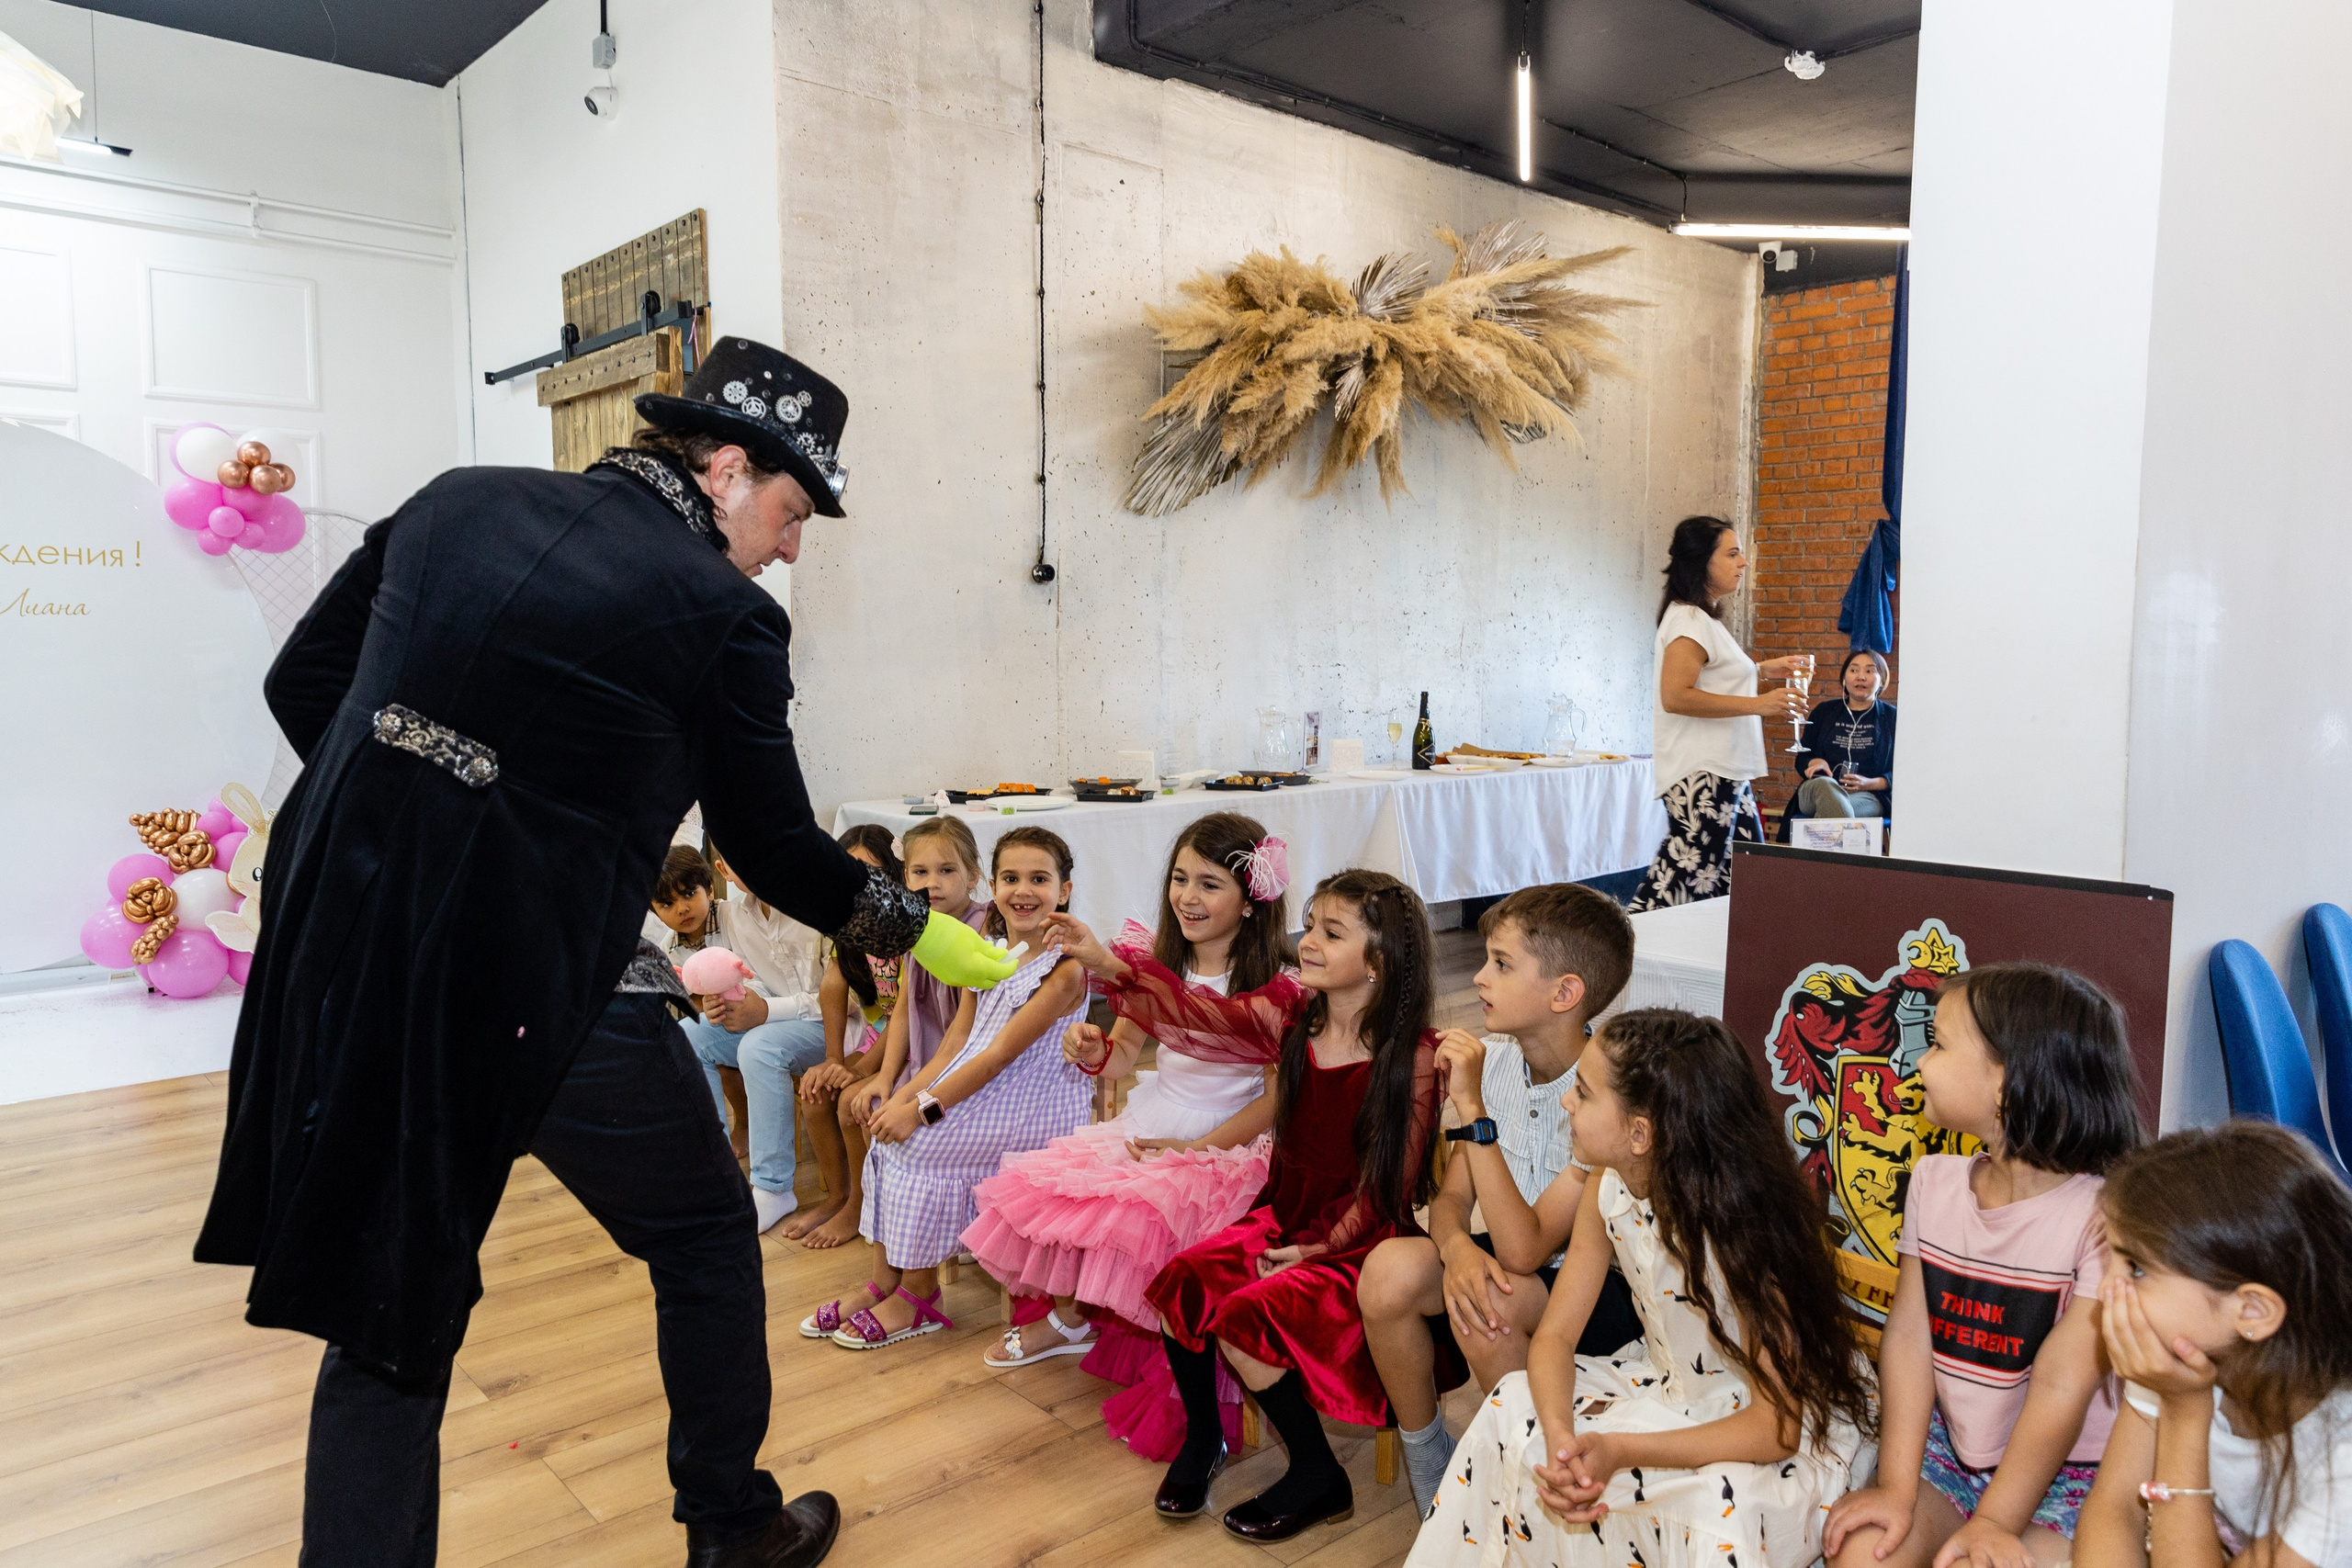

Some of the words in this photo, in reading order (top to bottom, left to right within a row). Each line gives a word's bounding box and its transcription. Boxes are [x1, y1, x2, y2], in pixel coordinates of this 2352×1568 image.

[0, 588, 91, 617] Лиана
[1940, 1291, 2005, 1325] THINK
[1929, 1314, 2024, 1357] IFFERENT
